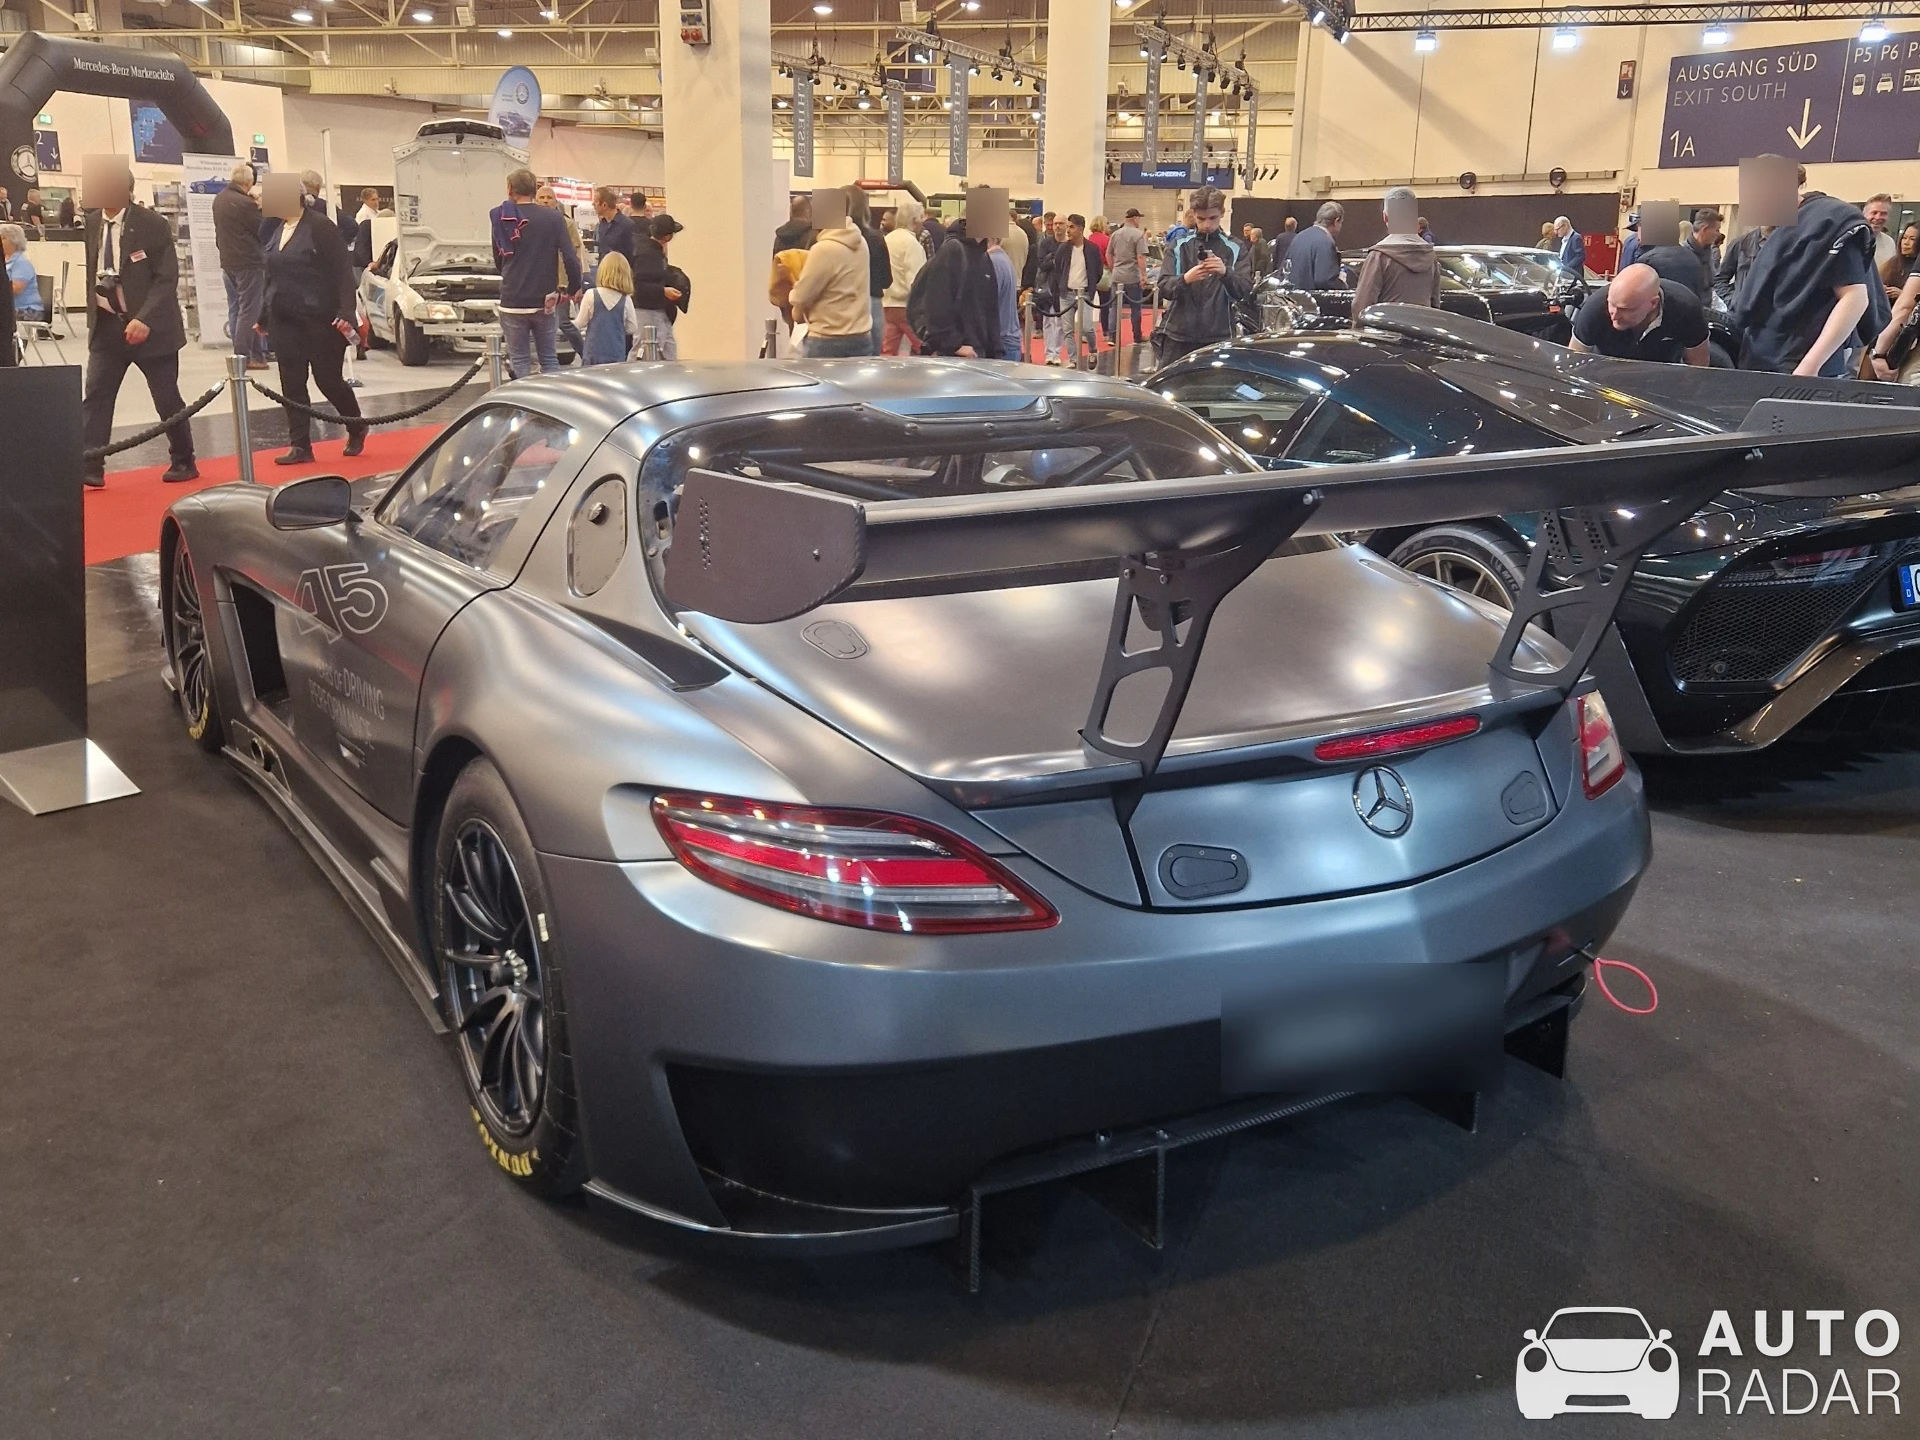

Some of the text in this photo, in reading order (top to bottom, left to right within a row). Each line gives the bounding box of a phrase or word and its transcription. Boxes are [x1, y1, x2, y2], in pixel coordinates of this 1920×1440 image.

[1854, 46, 1872, 63] P5
[1880, 43, 1899, 61] P6
[1908, 42, 1920, 58] P
[73, 56, 176, 82] Mercedes-Benz Markenclubs
[1675, 51, 1818, 83] AUSGANG SÜD
[1673, 81, 1788, 107] EXIT SOUTH
[989, 98, 998, 121] 1
[34, 130, 44, 145] 2
[1670, 129, 1696, 158] 1A
[251, 148, 258, 160] 2
[292, 562, 389, 645] 45
[343, 667, 385, 721] DRIVING
